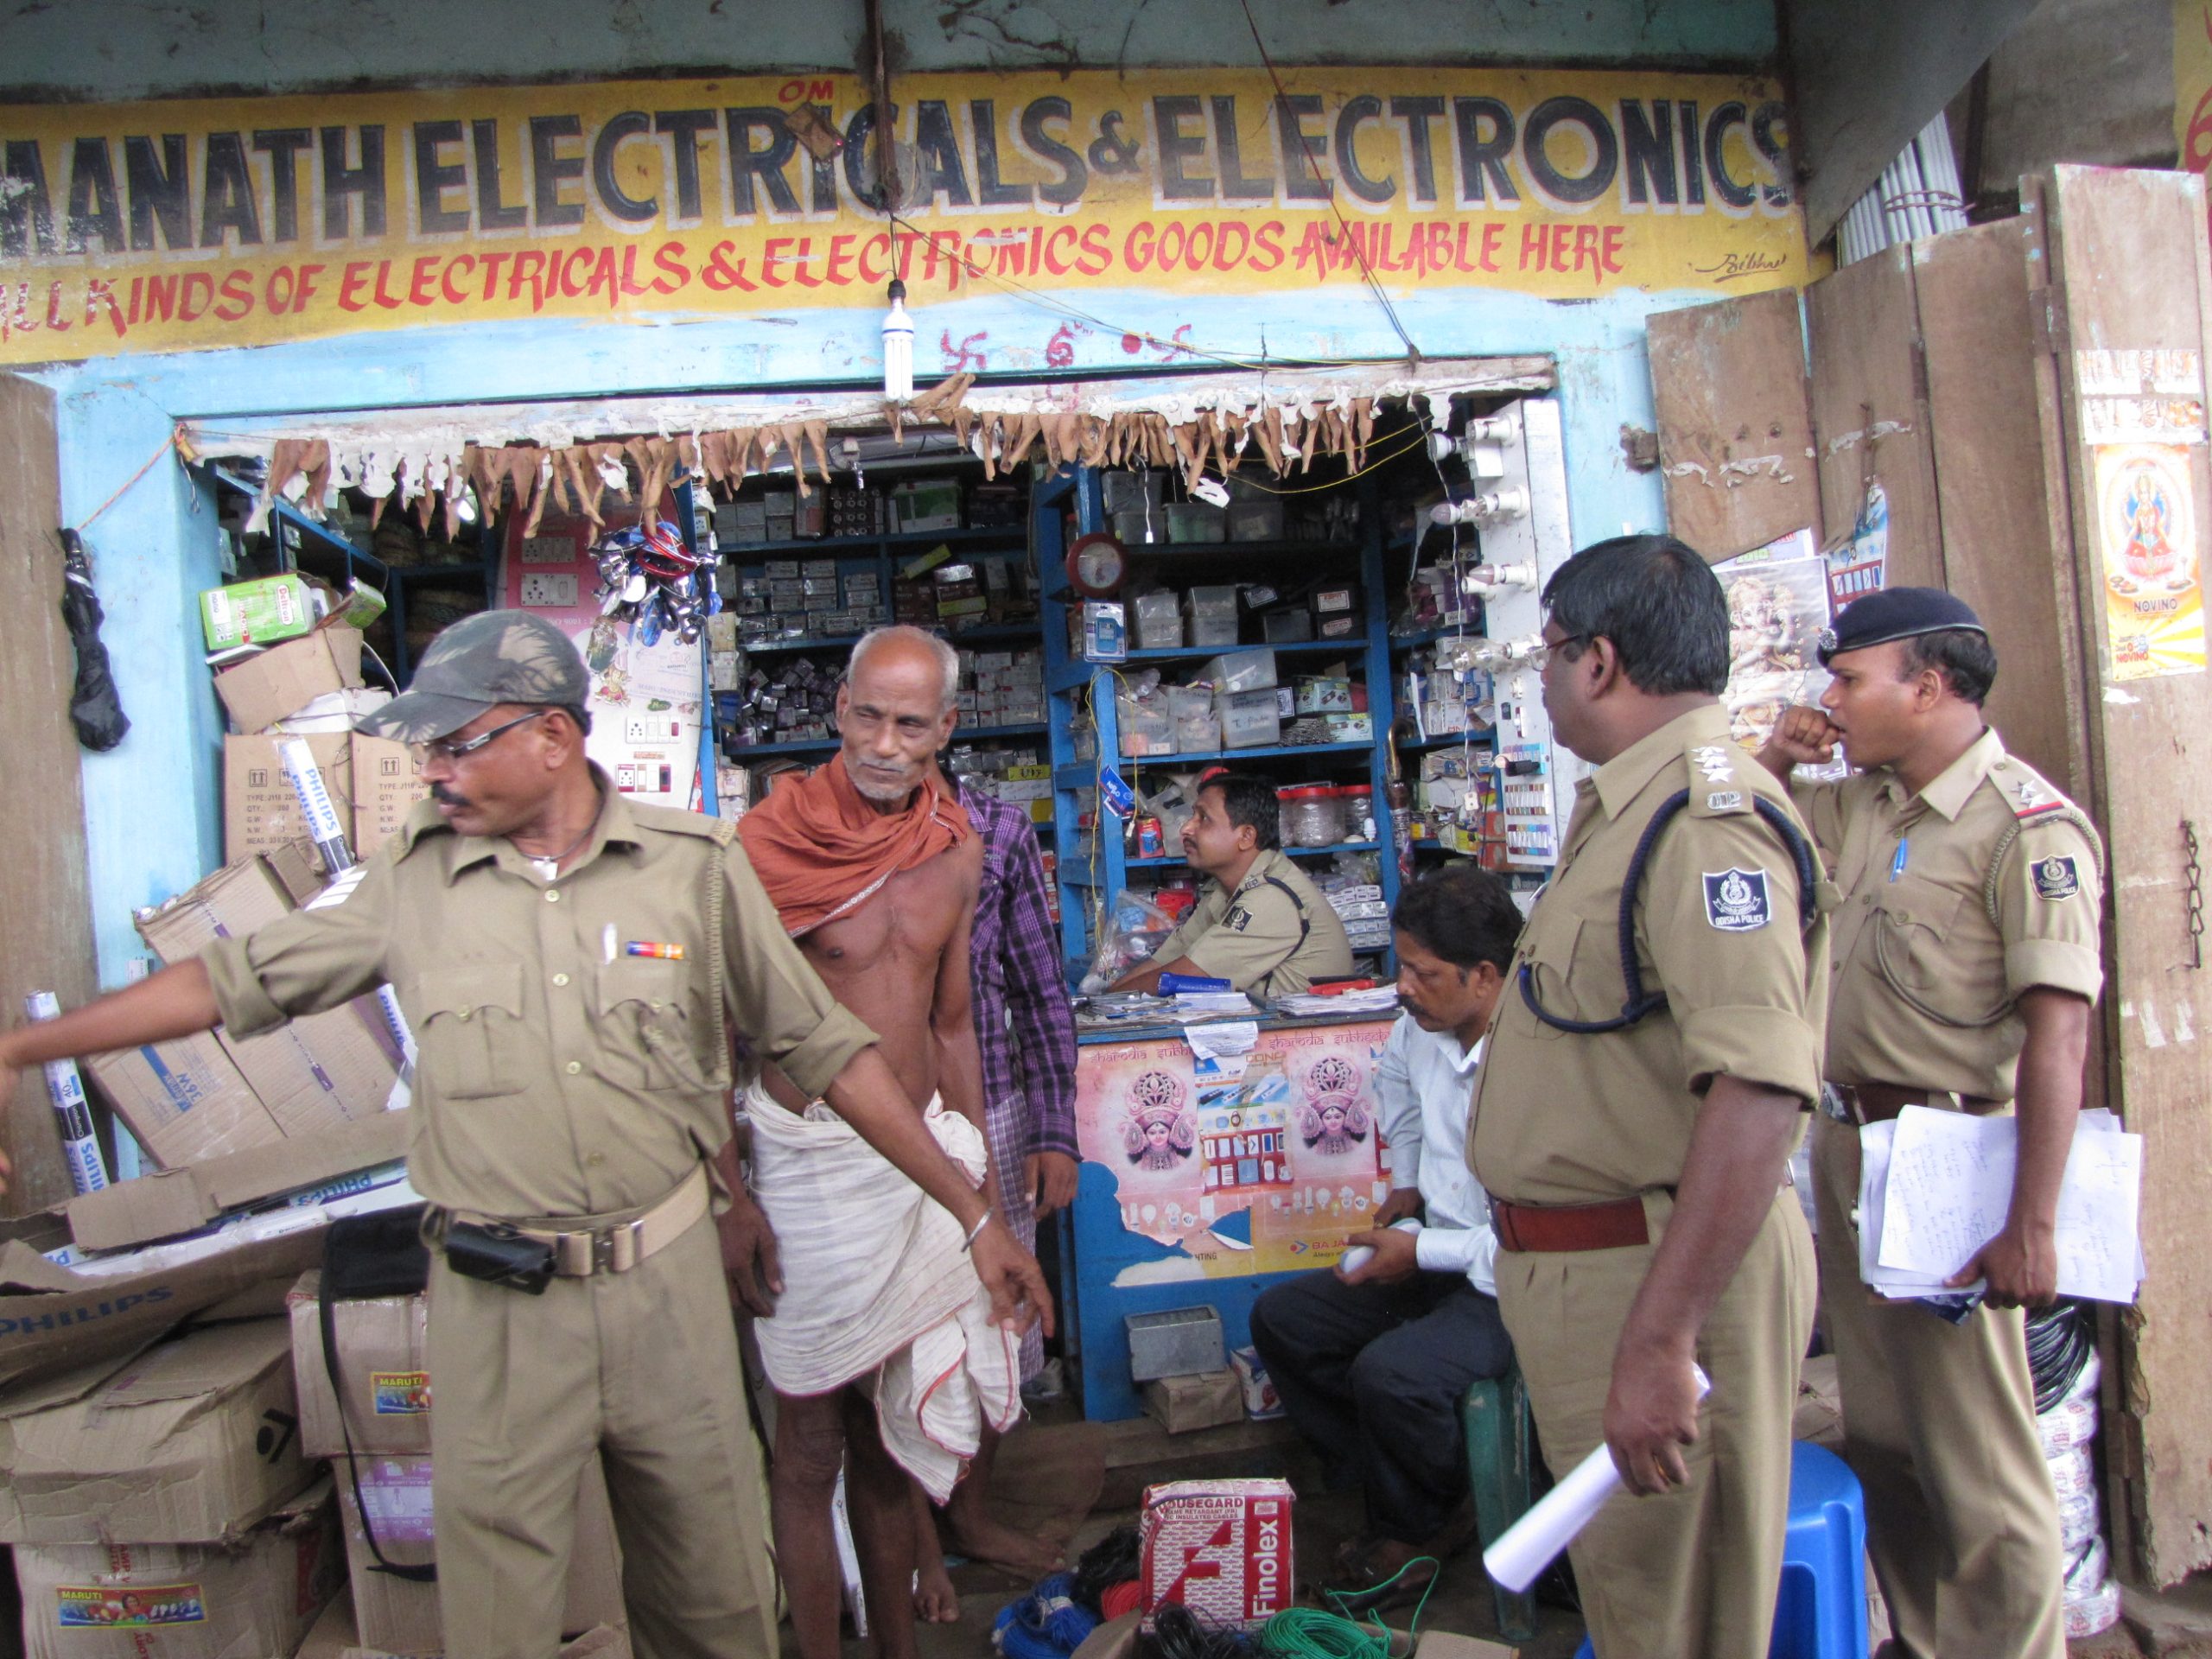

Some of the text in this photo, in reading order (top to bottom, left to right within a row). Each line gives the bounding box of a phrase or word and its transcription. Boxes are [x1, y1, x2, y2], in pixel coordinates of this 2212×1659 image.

[779, 79, 834, 103] OM
[1087, 110, 1141, 175] &
[1153, 94, 1796, 208] ELECTRONICS
[85, 269, 255, 339] KINDS
[265, 263, 327, 315] OF
[338, 241, 691, 313] ELECTRICALS
[702, 240, 760, 292] &
[761, 222, 1113, 292] ELECTRONICS
[1124, 220, 1284, 273] GOODS
[1292, 219, 1505, 283] AVAILABLE
[1518, 226, 1625, 284] HERE
[278, 588, 290, 622] Deltron
[2134, 598, 2177, 613] NOVINO
[2117, 652, 2149, 664] NOVINO
[305, 768, 338, 831] PHILIPS
[1715, 914, 1764, 926] ODISHA POLICE
[176, 1072, 203, 1102] 36W
[297, 1173, 373, 1207] PHILIPS
[1312, 1239, 1350, 1250] BAJA
[380, 1376, 423, 1387] MARUTI
[1253, 1519, 1279, 1618] Finolex
[61, 1591, 103, 1600] MARUTI
